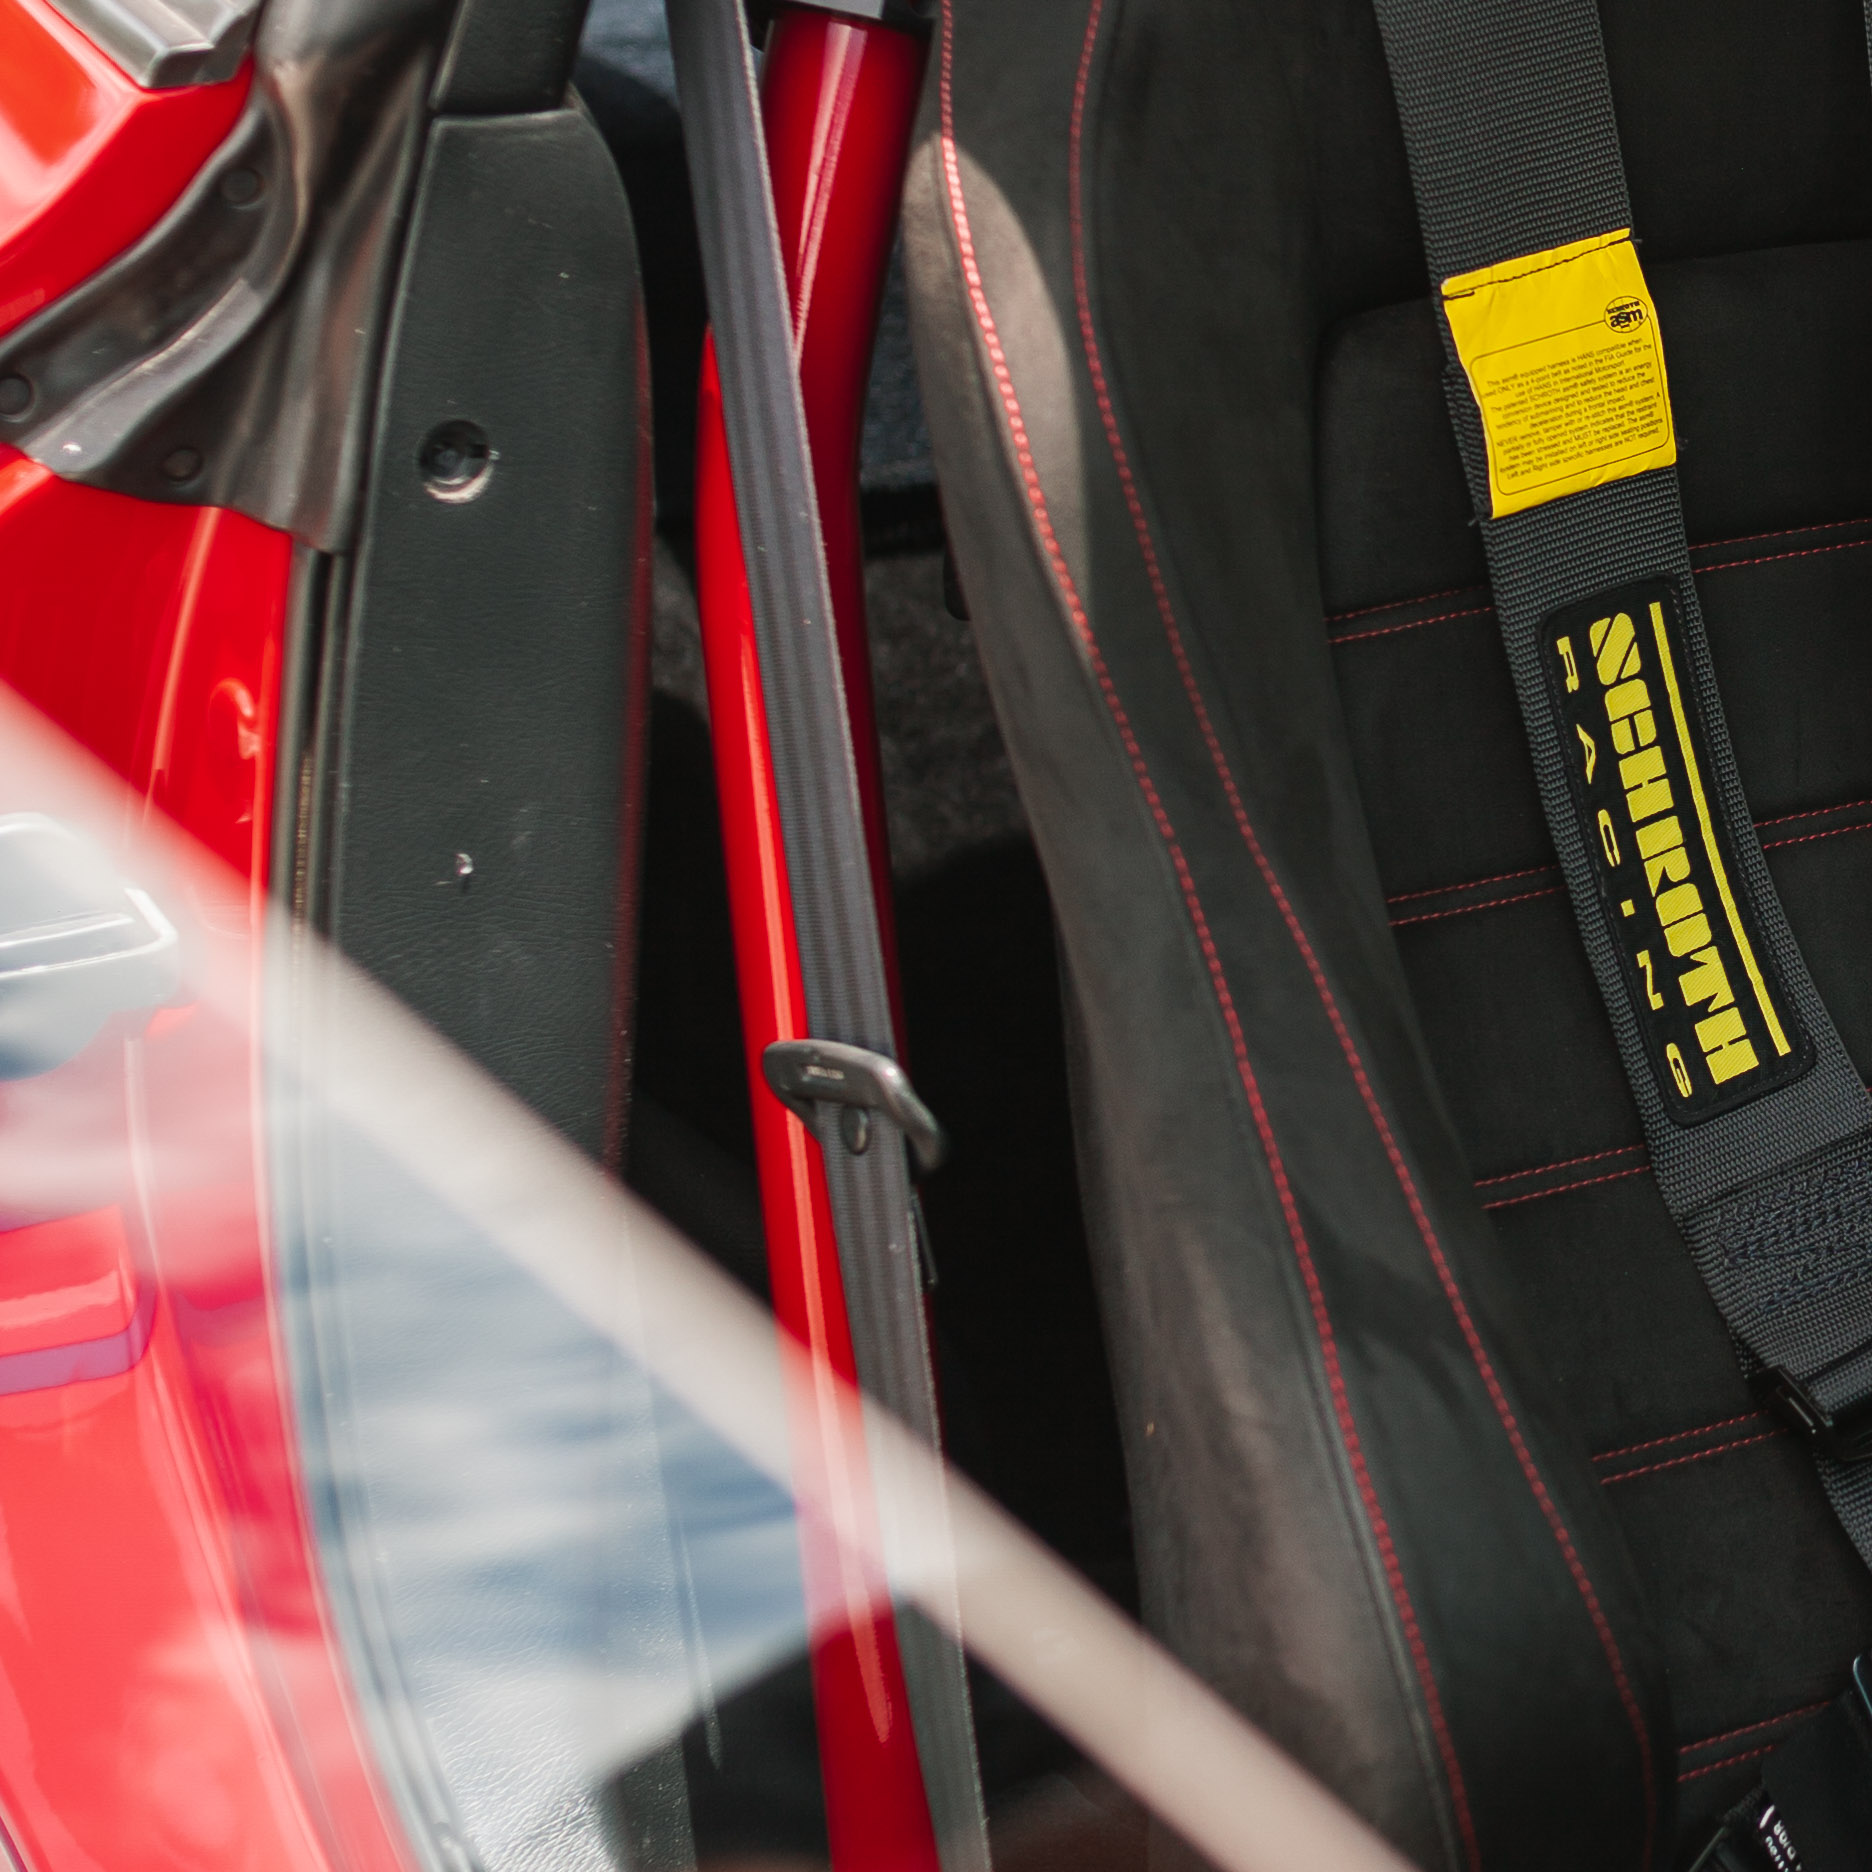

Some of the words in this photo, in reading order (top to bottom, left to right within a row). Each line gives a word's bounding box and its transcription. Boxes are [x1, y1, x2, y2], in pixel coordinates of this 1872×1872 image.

[1609, 308, 1643, 327] asm
[1557, 636, 1693, 1098] RACING
[1590, 612, 1759, 1085] SCHROTH
